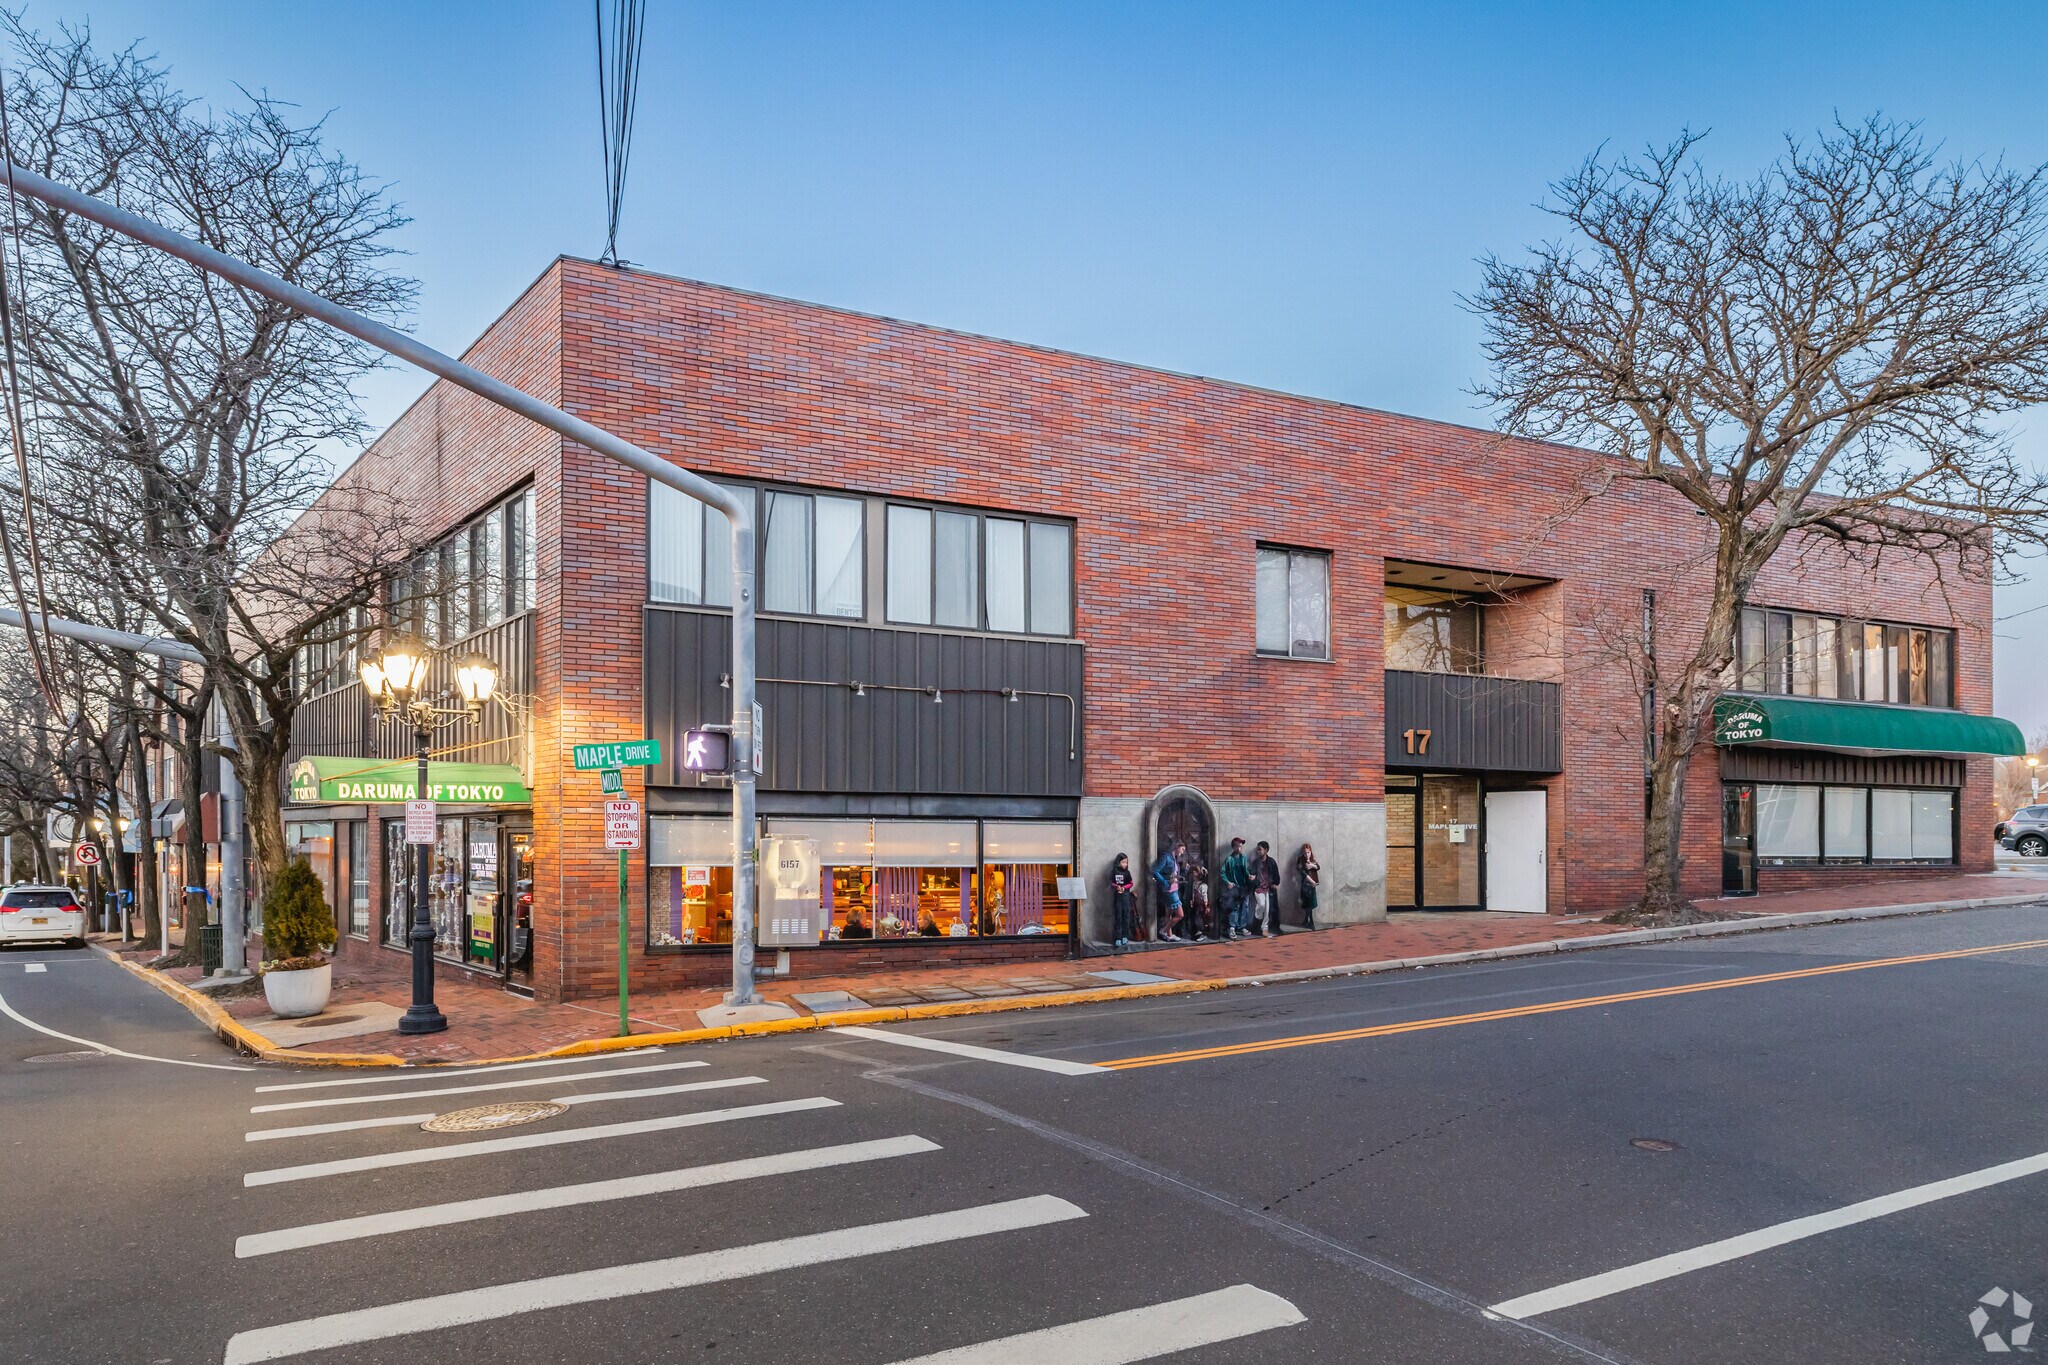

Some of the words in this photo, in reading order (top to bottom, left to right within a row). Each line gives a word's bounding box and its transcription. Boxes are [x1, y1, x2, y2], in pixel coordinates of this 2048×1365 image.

[1727, 712, 1763, 724] DARUMA
[1738, 721, 1749, 729] OF
[1725, 728, 1763, 740] TOKYO
[1403, 729, 1432, 754] 17
[576, 745, 622, 767] MAPLE
[625, 745, 650, 760] DRIVE
[294, 787, 317, 800] TOKYO
[338, 783, 416, 799] DARUMA
[446, 785, 503, 800] TOKYO
[613, 803, 631, 811] NO
[607, 813, 638, 822] STOPPING
[607, 830, 638, 839] STANDING
[470, 843, 496, 858] DARUMA
[780, 860, 800, 869] 6157
